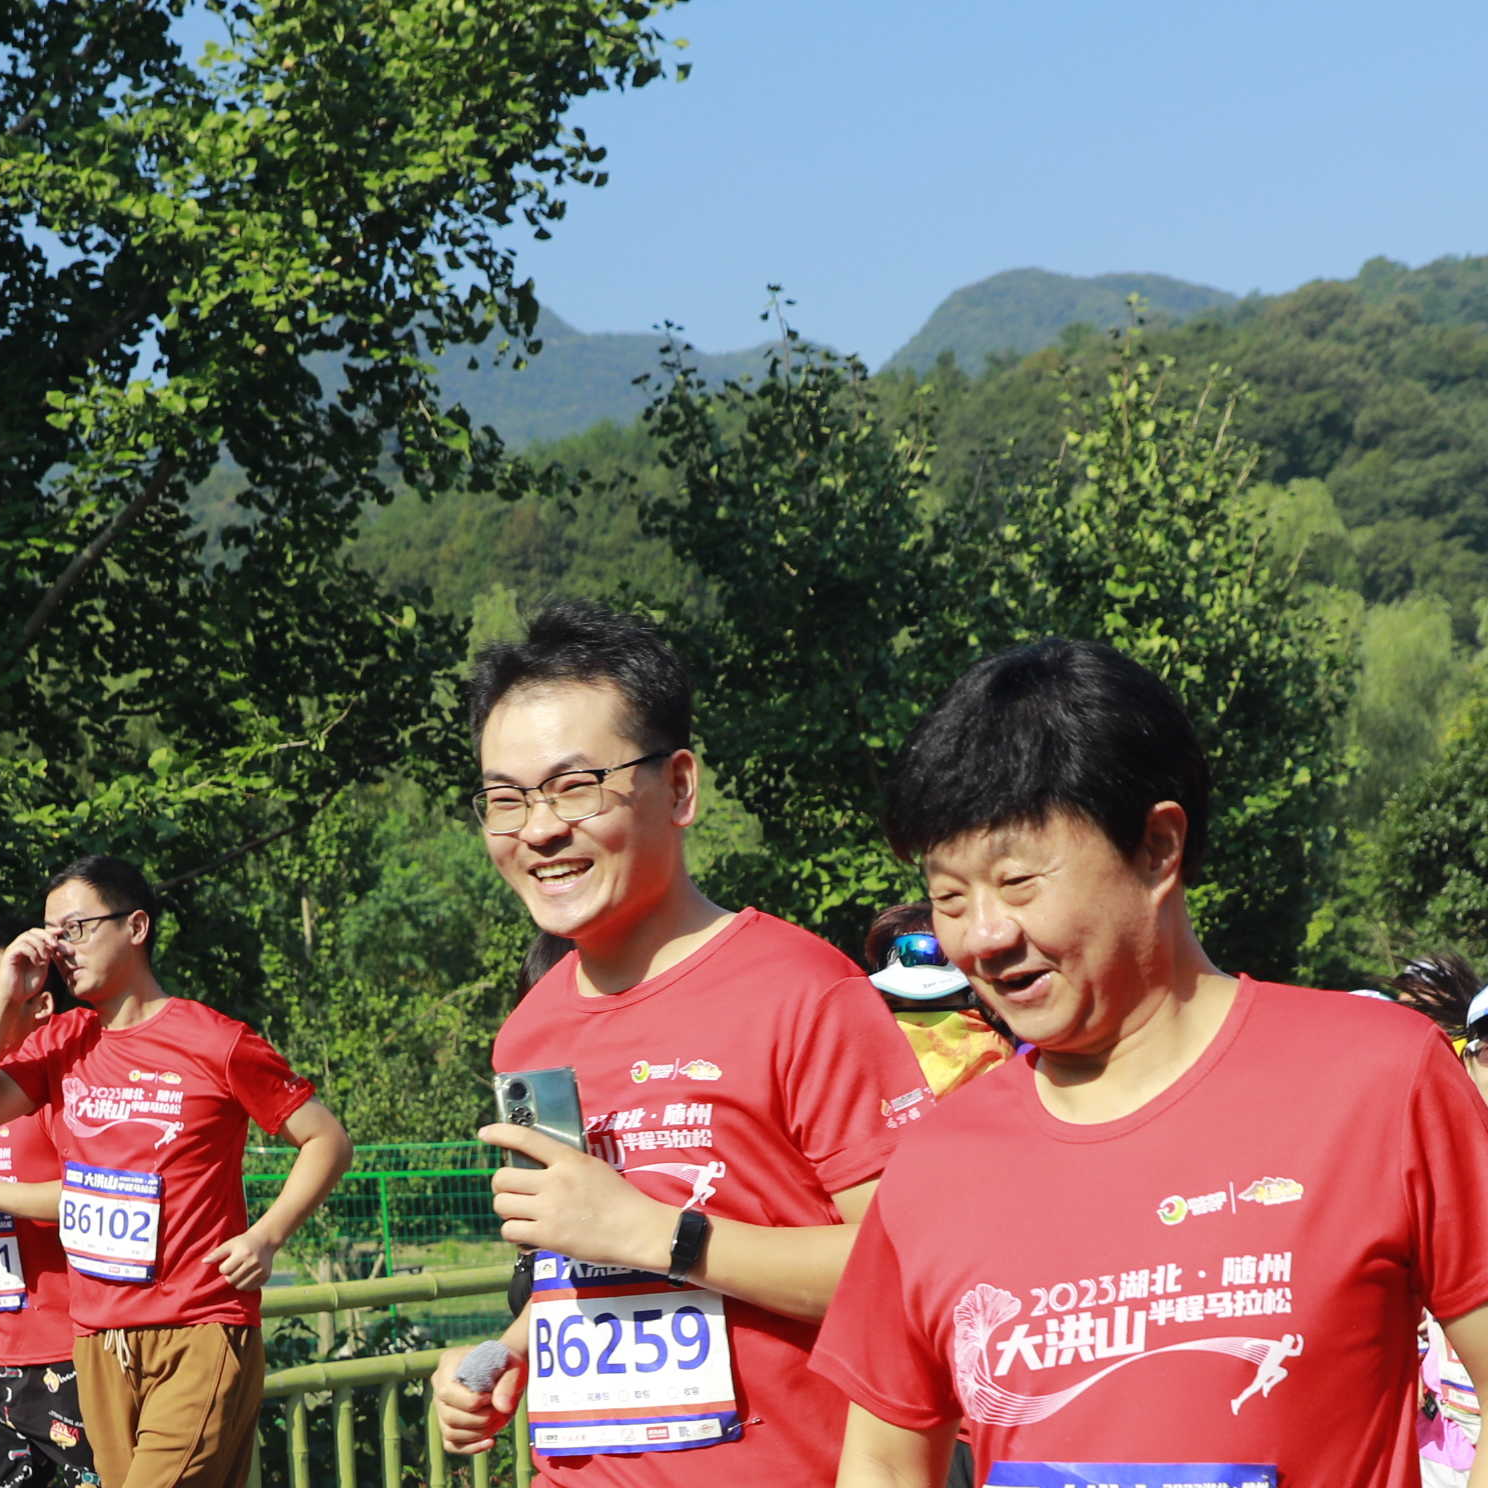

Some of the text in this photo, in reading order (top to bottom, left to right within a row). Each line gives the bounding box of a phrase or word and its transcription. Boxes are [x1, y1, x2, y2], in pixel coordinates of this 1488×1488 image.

[622, 1129, 713, 1151] 半程马拉松
[64, 1200, 150, 1243] B6102
[537, 1306, 710, 1378] B6259
[993, 1287, 1293, 1377] 大洪山 半程马拉松
